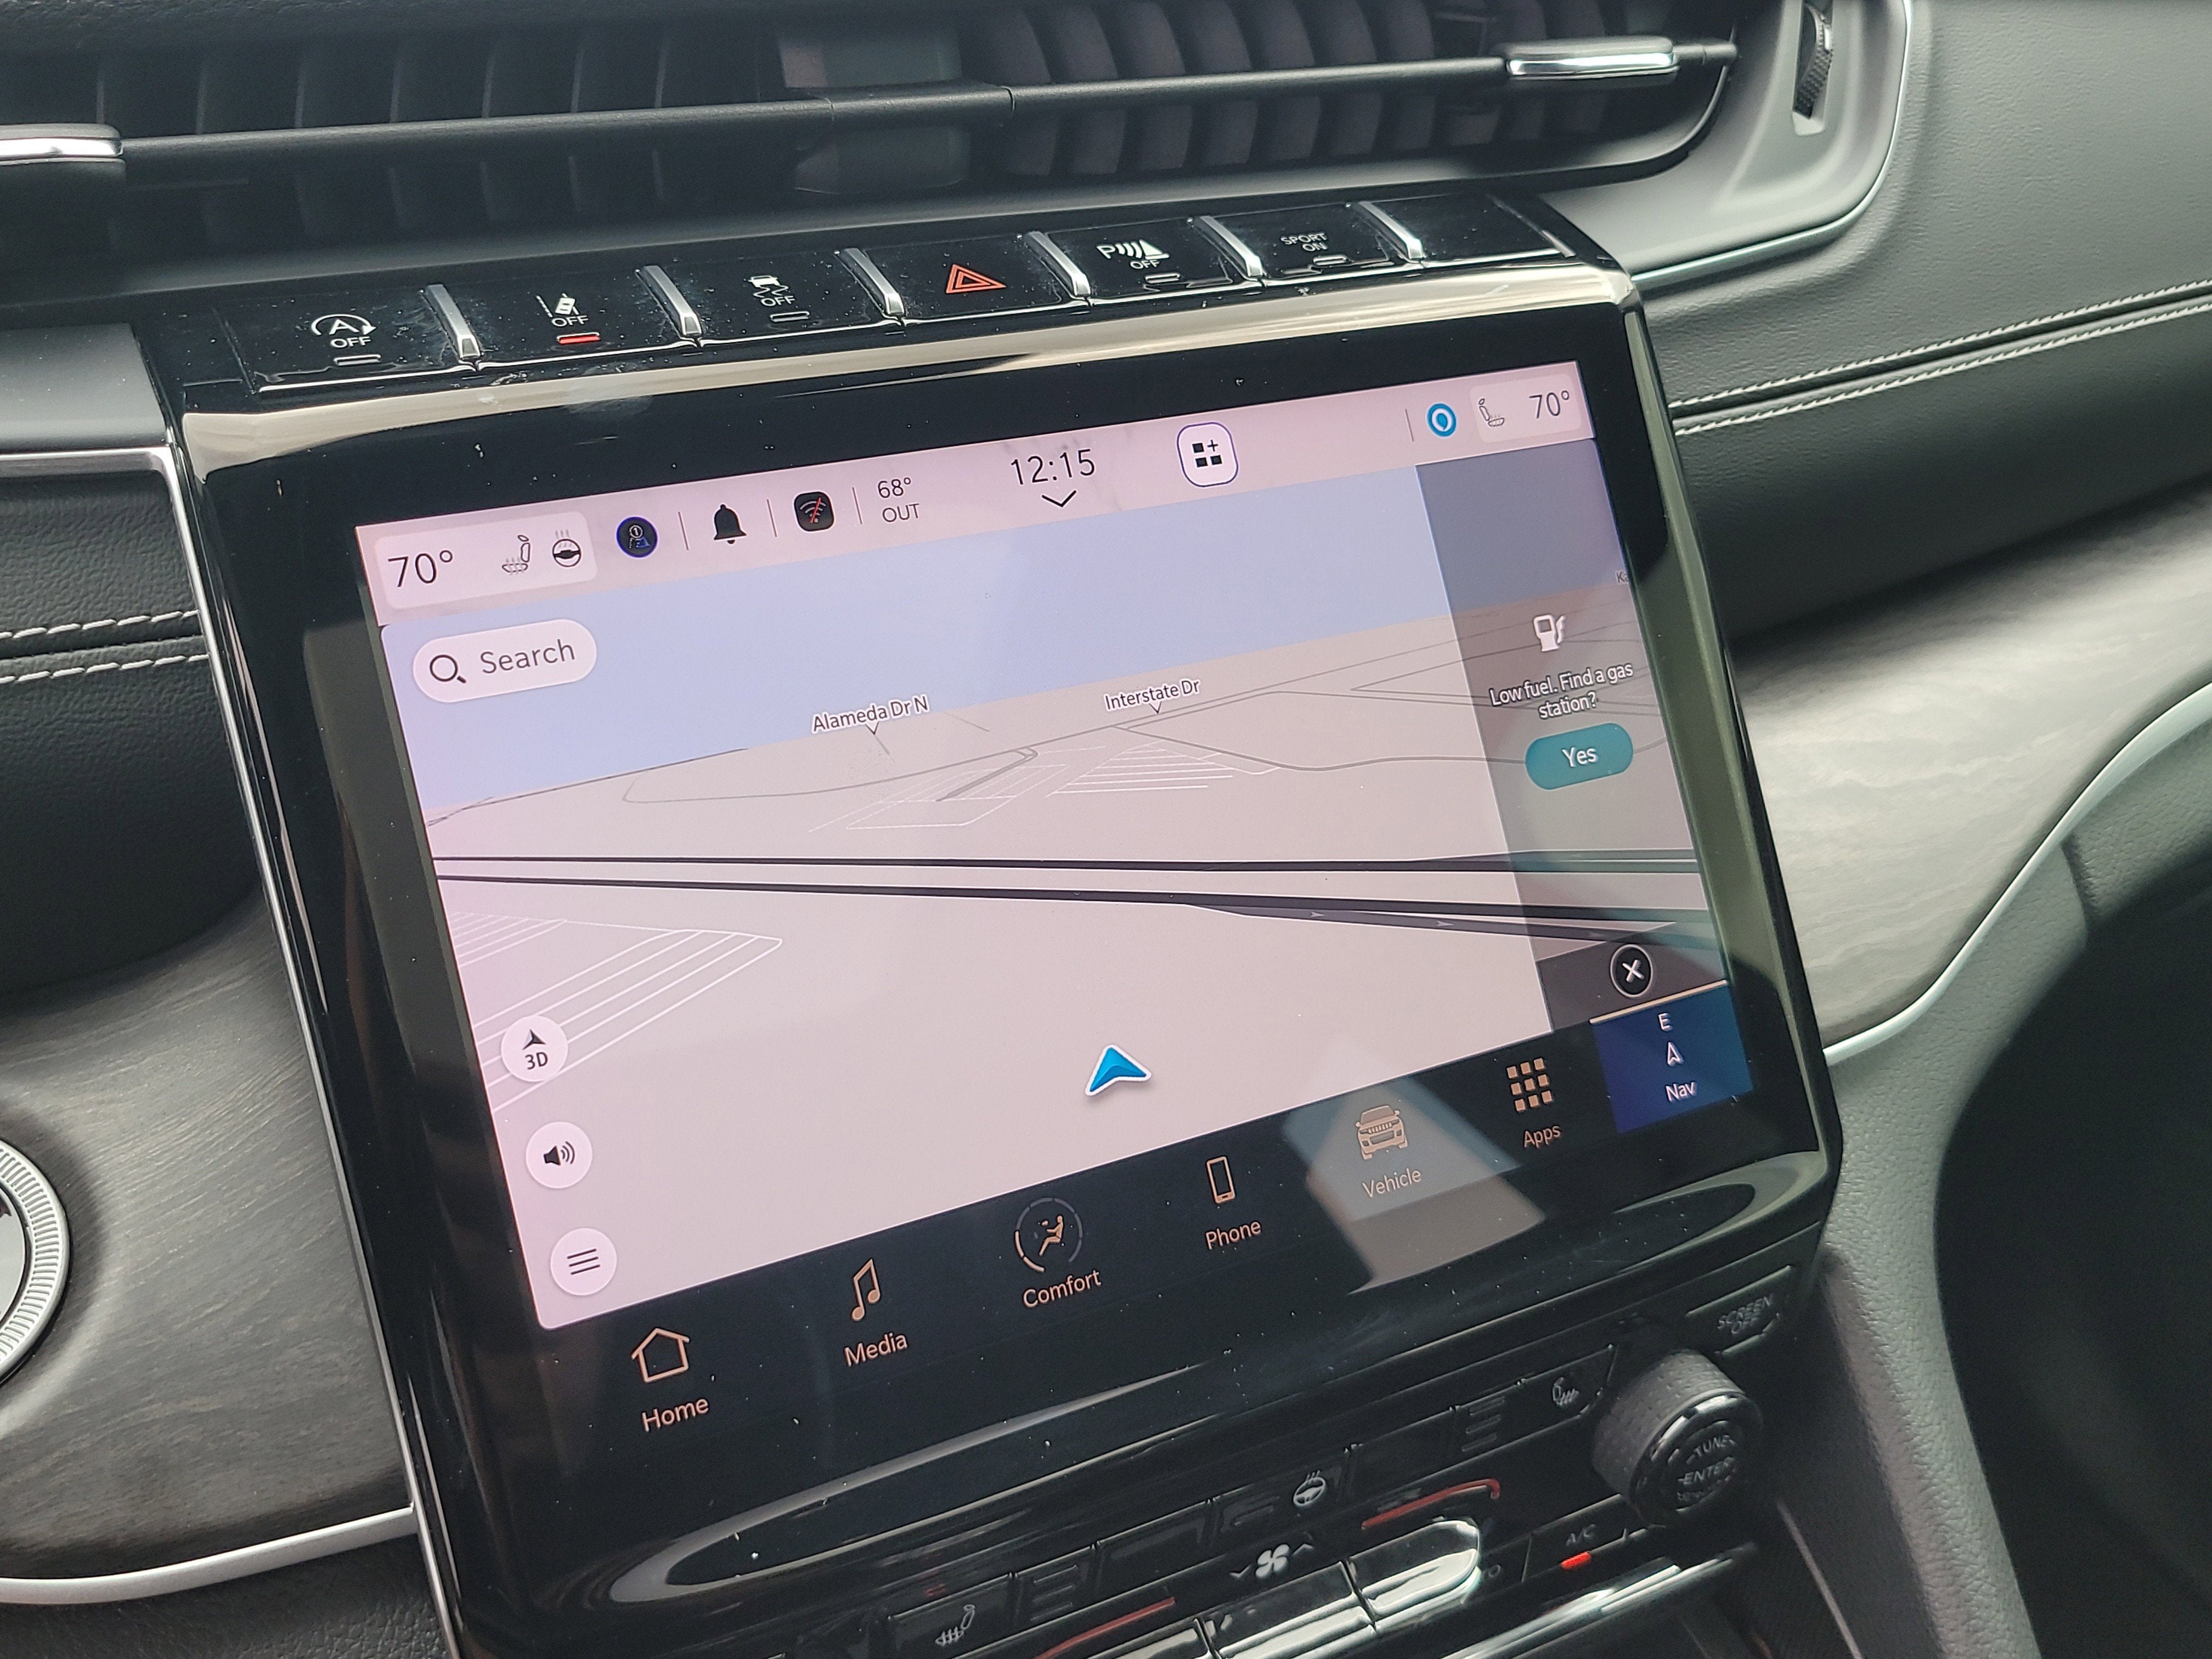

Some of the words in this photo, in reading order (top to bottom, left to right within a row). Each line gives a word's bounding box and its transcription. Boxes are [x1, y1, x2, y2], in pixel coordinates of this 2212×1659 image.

[1280, 232, 1328, 245] SPORT
[1302, 242, 1328, 252] ON
[1130, 259, 1160, 269] OFF
[760, 296, 795, 307] OFF
[551, 315, 589, 327] OFF
[330, 336, 371, 348] OFF
[1528, 390, 1570, 419] 70°
[1011, 448, 1095, 485] 12:15
[878, 477, 911, 498] 68°
[882, 503, 920, 522] OUT
[388, 550, 453, 587] 70°
[480, 639, 575, 674] Search
[1105, 685, 1180, 710] Interstate
[1181, 680, 1199, 695] Dr
[1489, 687, 1522, 707] Low
[1523, 675, 1558, 699] fuel.
[1559, 667, 1593, 692] Find
[1595, 670, 1605, 683] a
[1607, 663, 1634, 684] gas
[813, 704, 888, 732] Alameda
[890, 701, 911, 716] Dr
[914, 696, 928, 713] N
[1538, 691, 1596, 719] station?
[1562, 746, 1599, 769] Yes
[1657, 1013, 1673, 1031] E
[524, 1052, 549, 1070] 3D
[1665, 1080, 1697, 1103] Nav
[1523, 1124, 1561, 1149] Apps
[1362, 1167, 1423, 1198] Vehicle
[1205, 1220, 1261, 1250] Phone
[1022, 1269, 1102, 1309] Comfort
[1717, 1293, 1775, 1329] SCREEN
[843, 1332, 909, 1367] Media
[642, 1396, 710, 1432] Home
[1693, 1435, 1731, 1457] TUNE
[1566, 1523, 1596, 1546] A/C
